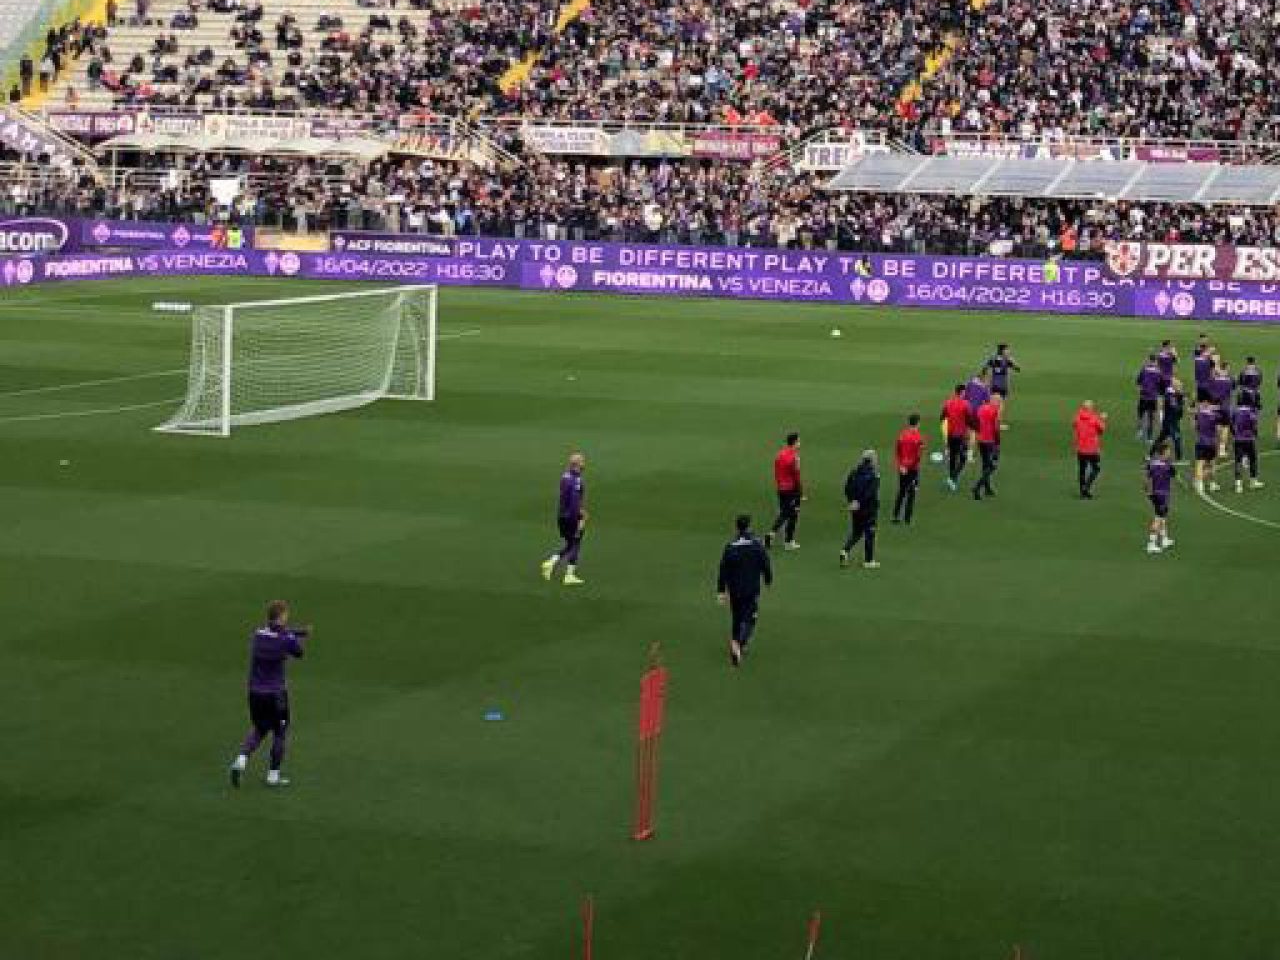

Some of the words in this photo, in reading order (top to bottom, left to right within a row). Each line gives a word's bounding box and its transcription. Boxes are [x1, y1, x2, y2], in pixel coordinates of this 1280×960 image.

[44, 256, 133, 277] FIORENTINA
[137, 255, 159, 271] VS
[162, 254, 248, 270] VENEZIA
[314, 256, 429, 276] 16/04/2022
[459, 242, 520, 260] PLAY
[530, 245, 561, 261] TO
[572, 247, 604, 263] BE
[620, 249, 759, 270] DIFFERENT
[764, 255, 829, 274] PLAY
[884, 260, 916, 277] BE
[932, 262, 1077, 284] DIFFERET
[1144, 243, 1216, 278] PER
[592, 269, 713, 289] FIORENTINA
[718, 276, 742, 291] VS
[749, 278, 832, 297] VENEZIA
[905, 283, 1031, 305] 16/04/2022
